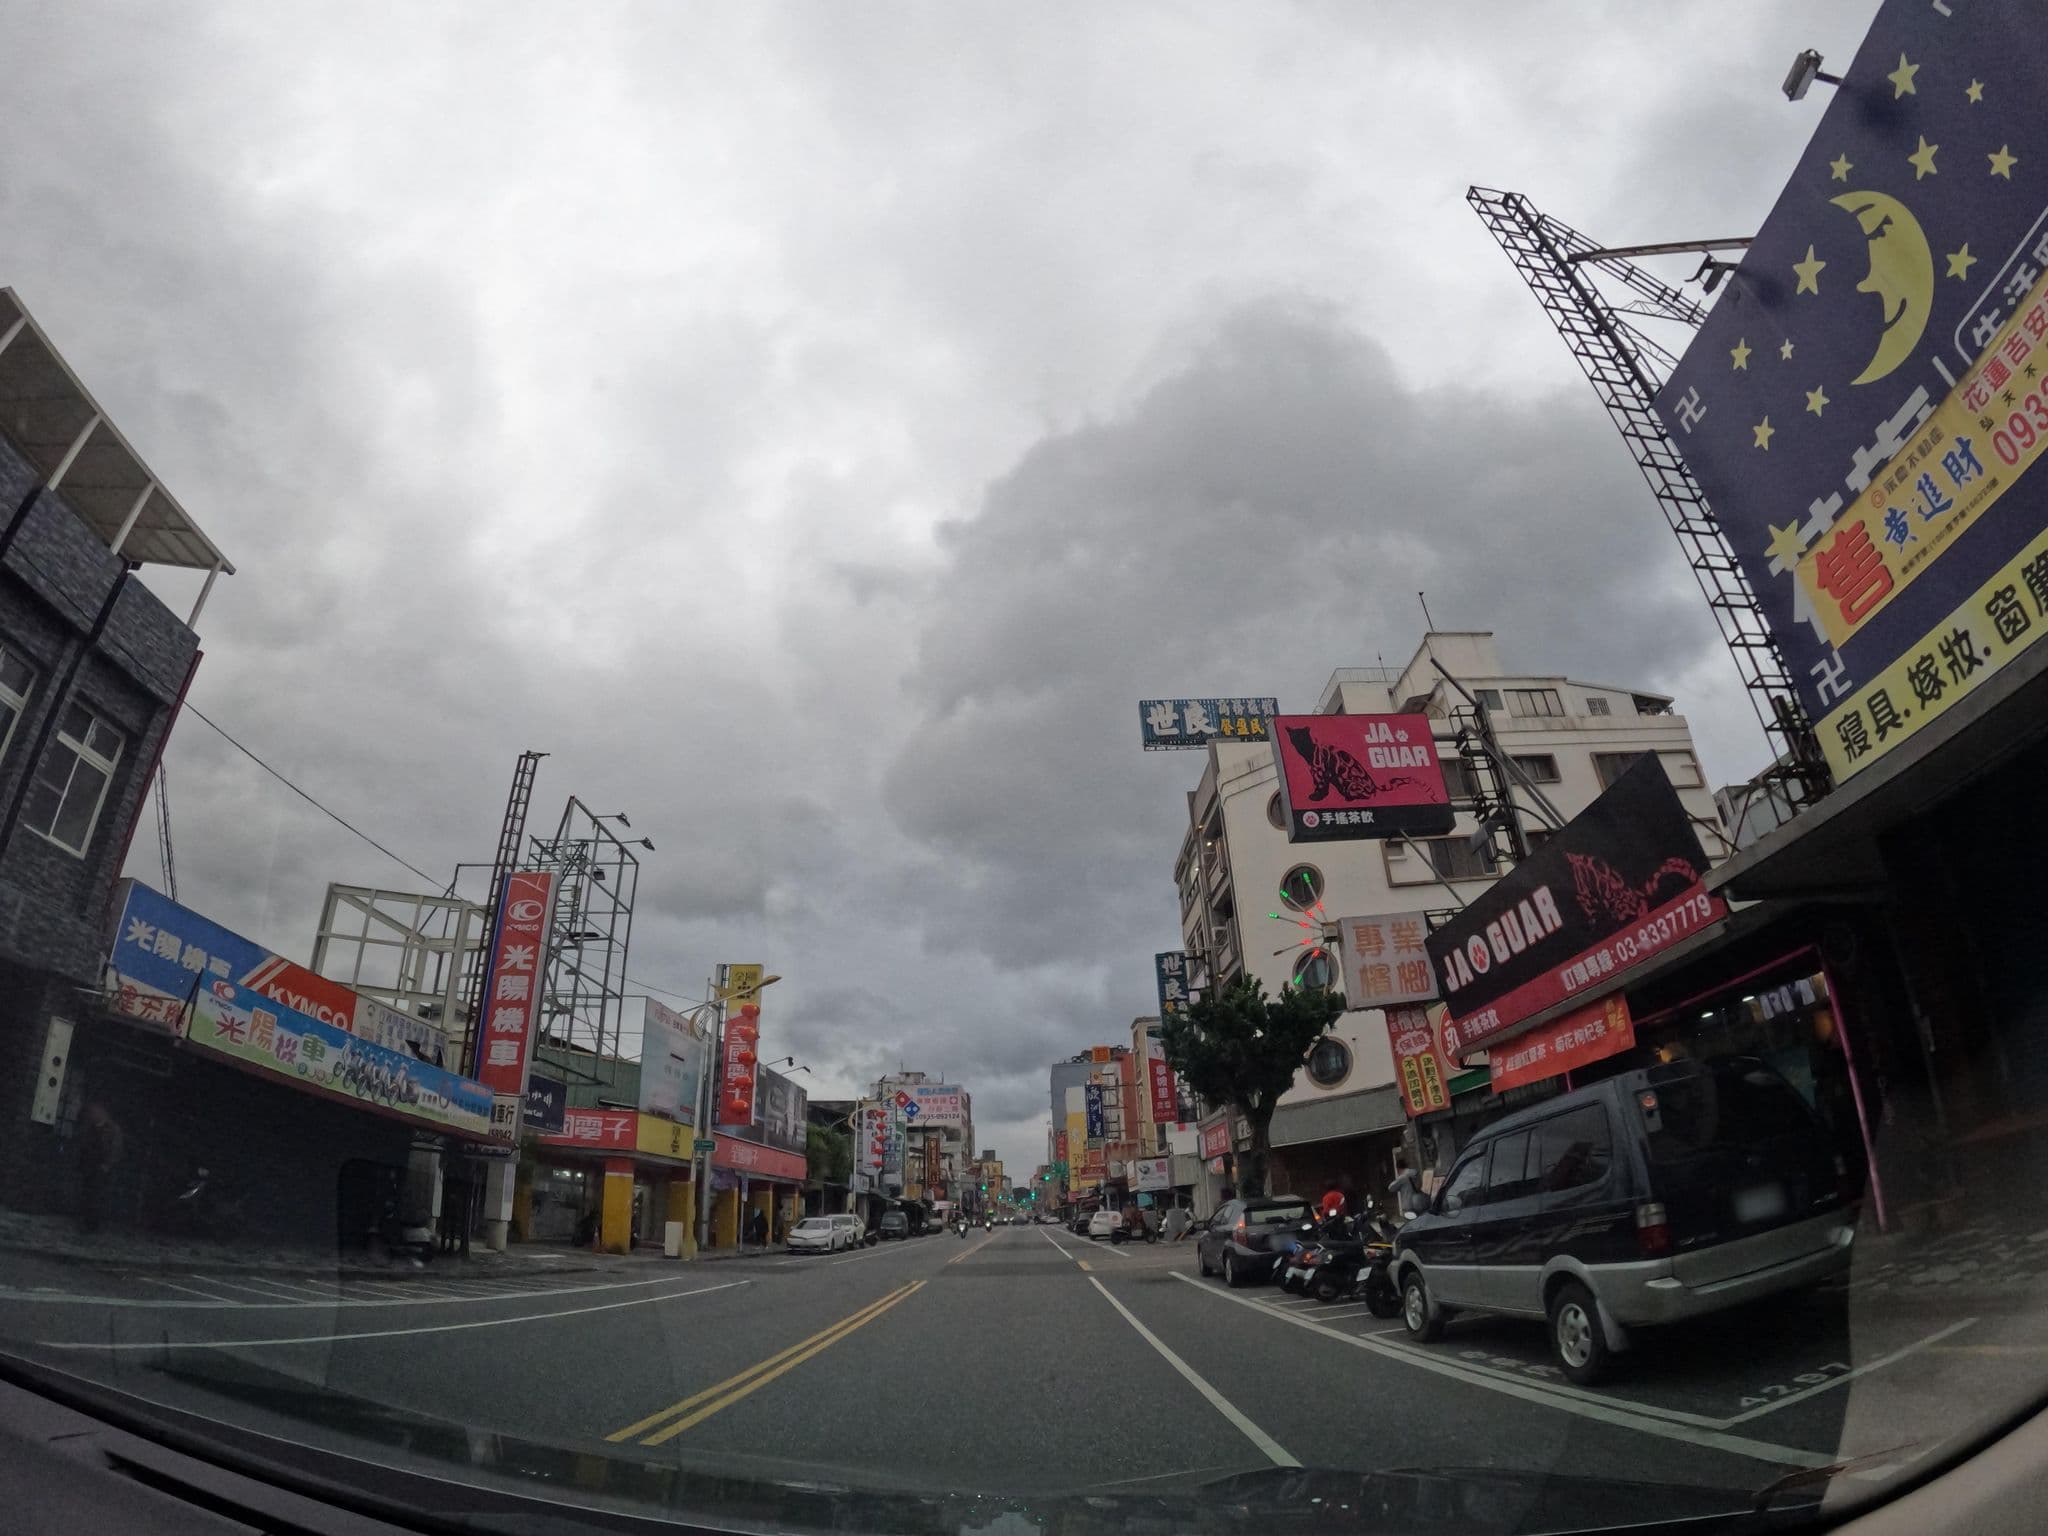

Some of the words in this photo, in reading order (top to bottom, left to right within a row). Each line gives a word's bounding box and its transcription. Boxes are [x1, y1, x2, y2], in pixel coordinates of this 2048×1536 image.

[1961, 287, 2048, 414] 花蓮吉安
[1884, 436, 1986, 554] 黃進財
[1815, 519, 1895, 625] 售
[1146, 699, 1217, 736] 世良
[1368, 745, 1432, 769] GUAR
[1321, 810, 1375, 826] 手搖茶飲
[1353, 920, 1424, 957] 專業
[1162, 954, 1189, 1000] 世良
[265, 981, 349, 1030] KYMCO
[487, 944, 535, 1067] 光陽機車
[1463, 1008, 1501, 1038] 手搖茶飲
[213, 1006, 327, 1066] 光陽機車
